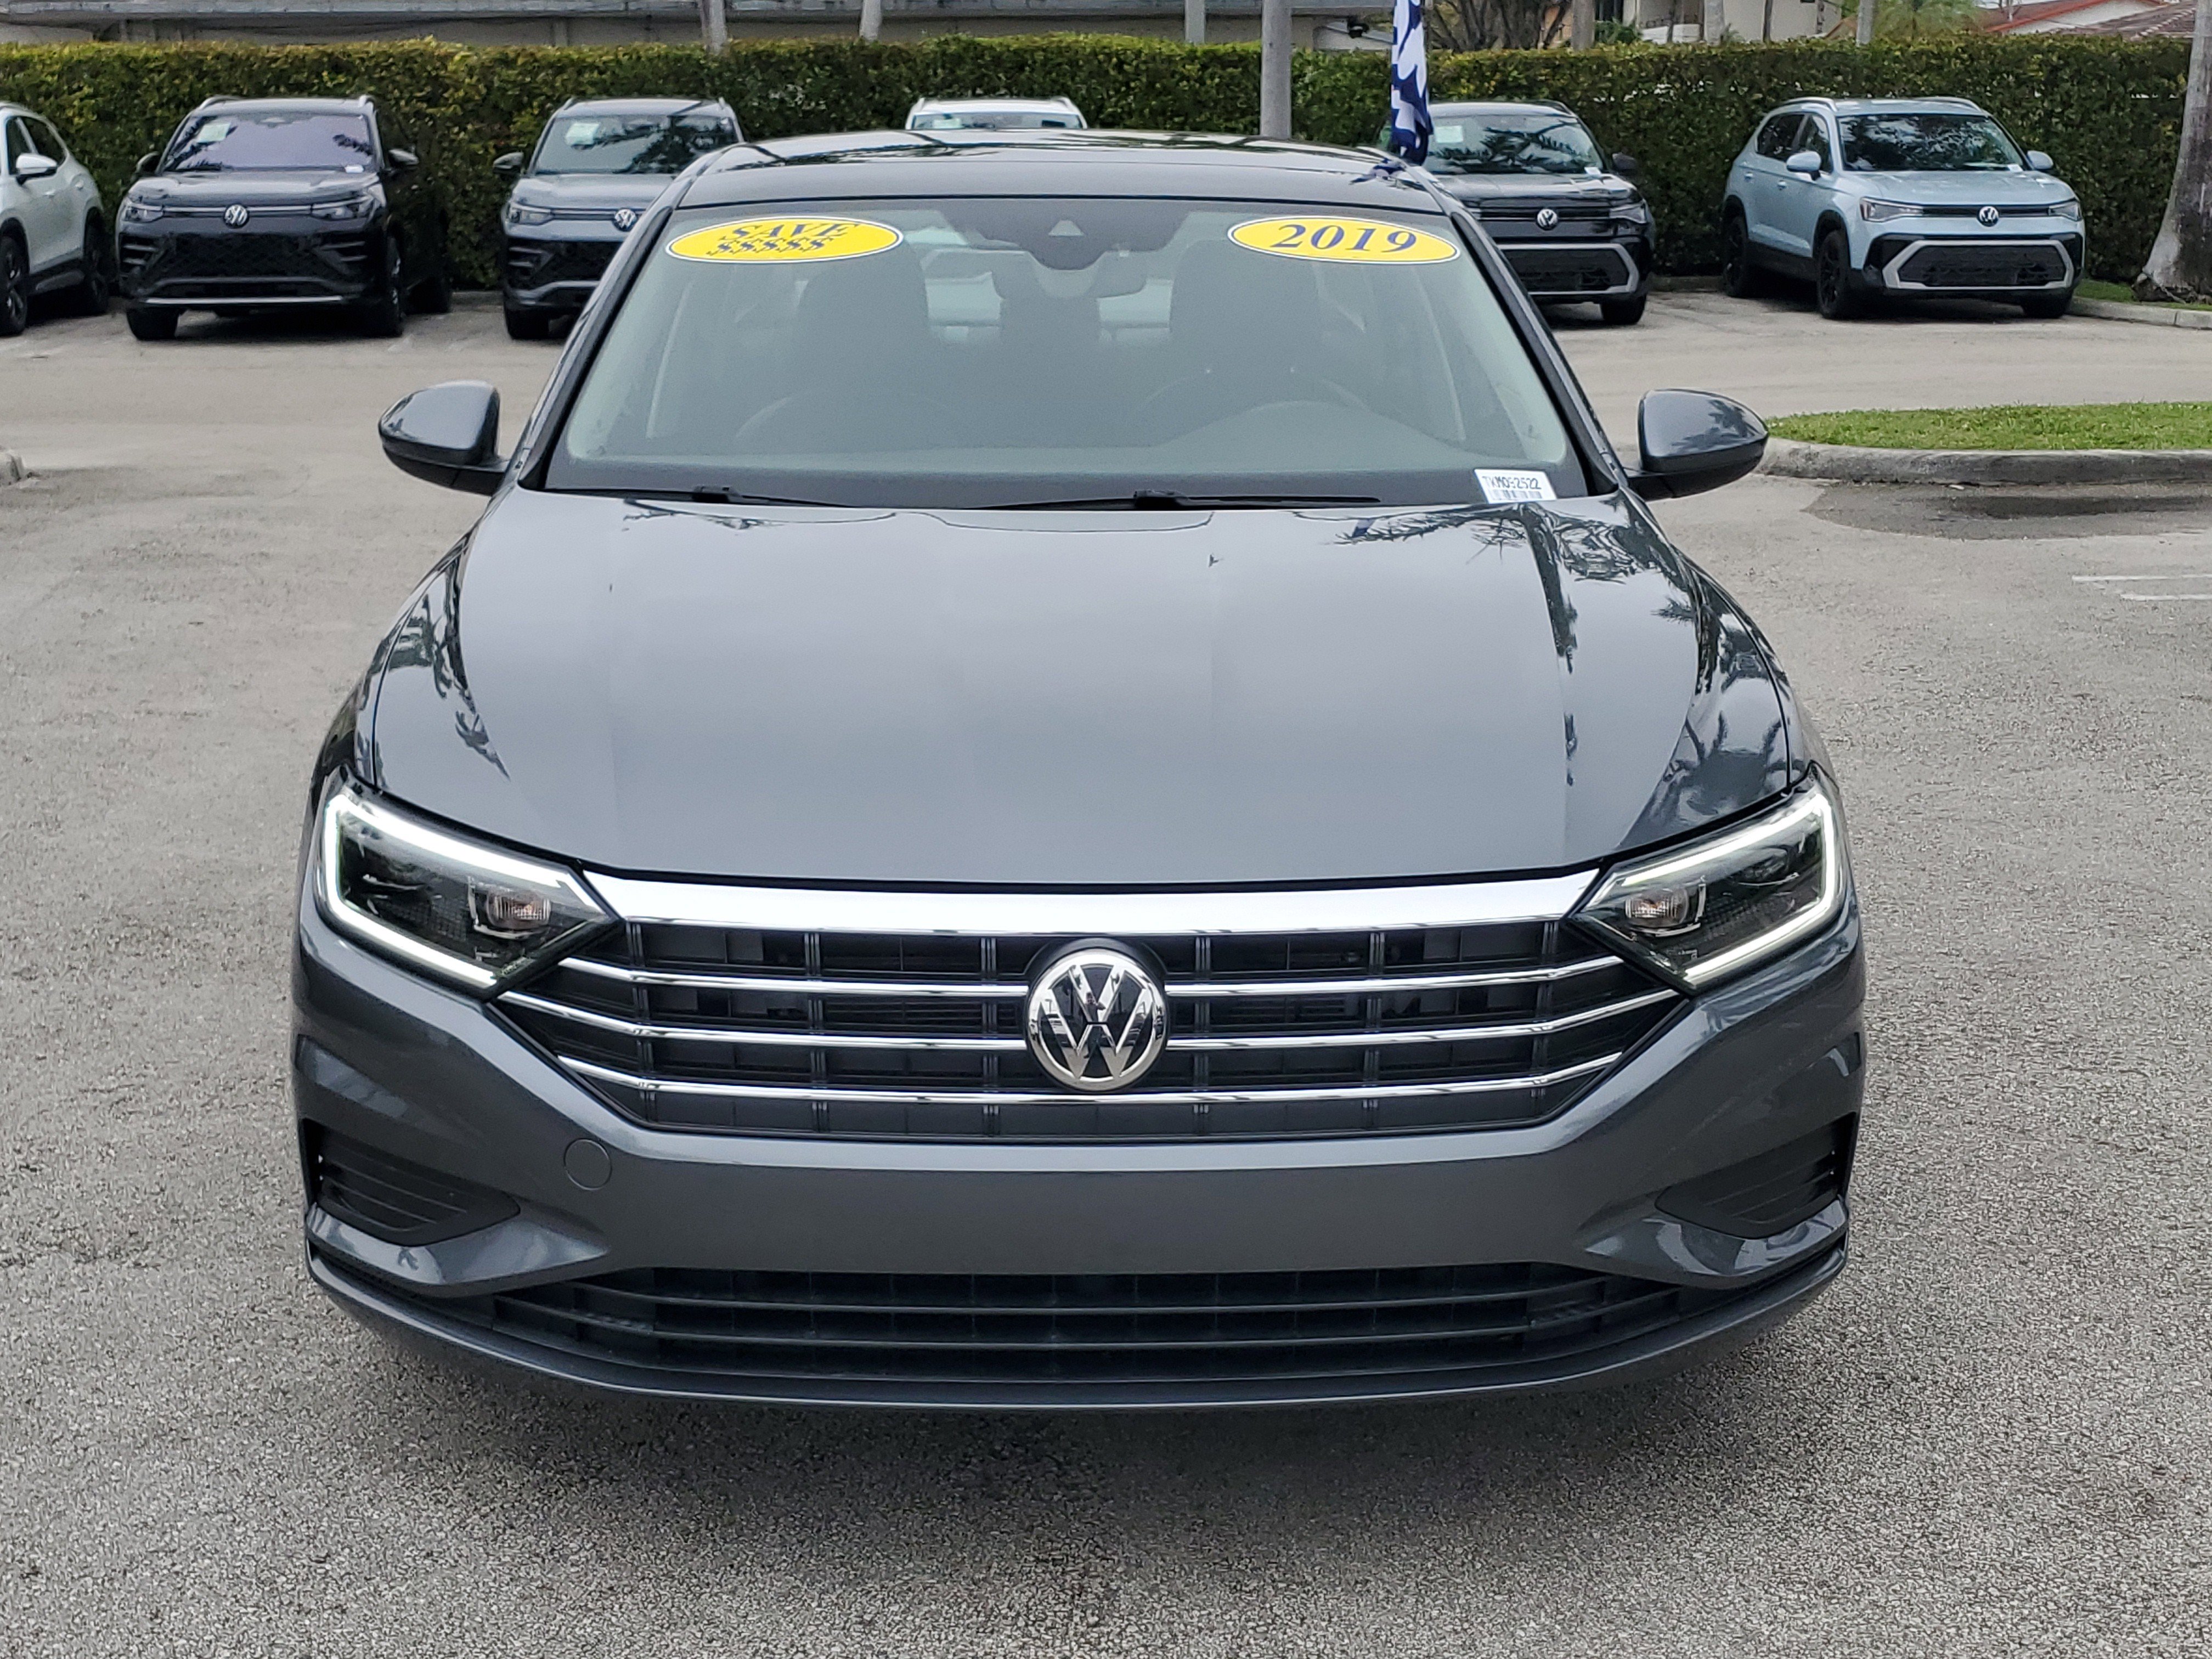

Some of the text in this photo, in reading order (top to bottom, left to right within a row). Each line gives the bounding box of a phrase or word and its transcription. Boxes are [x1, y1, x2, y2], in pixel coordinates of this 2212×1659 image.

[718, 223, 860, 240] SAVE
[1270, 224, 1417, 253] 2019
[1034, 955, 1160, 1085] VW
